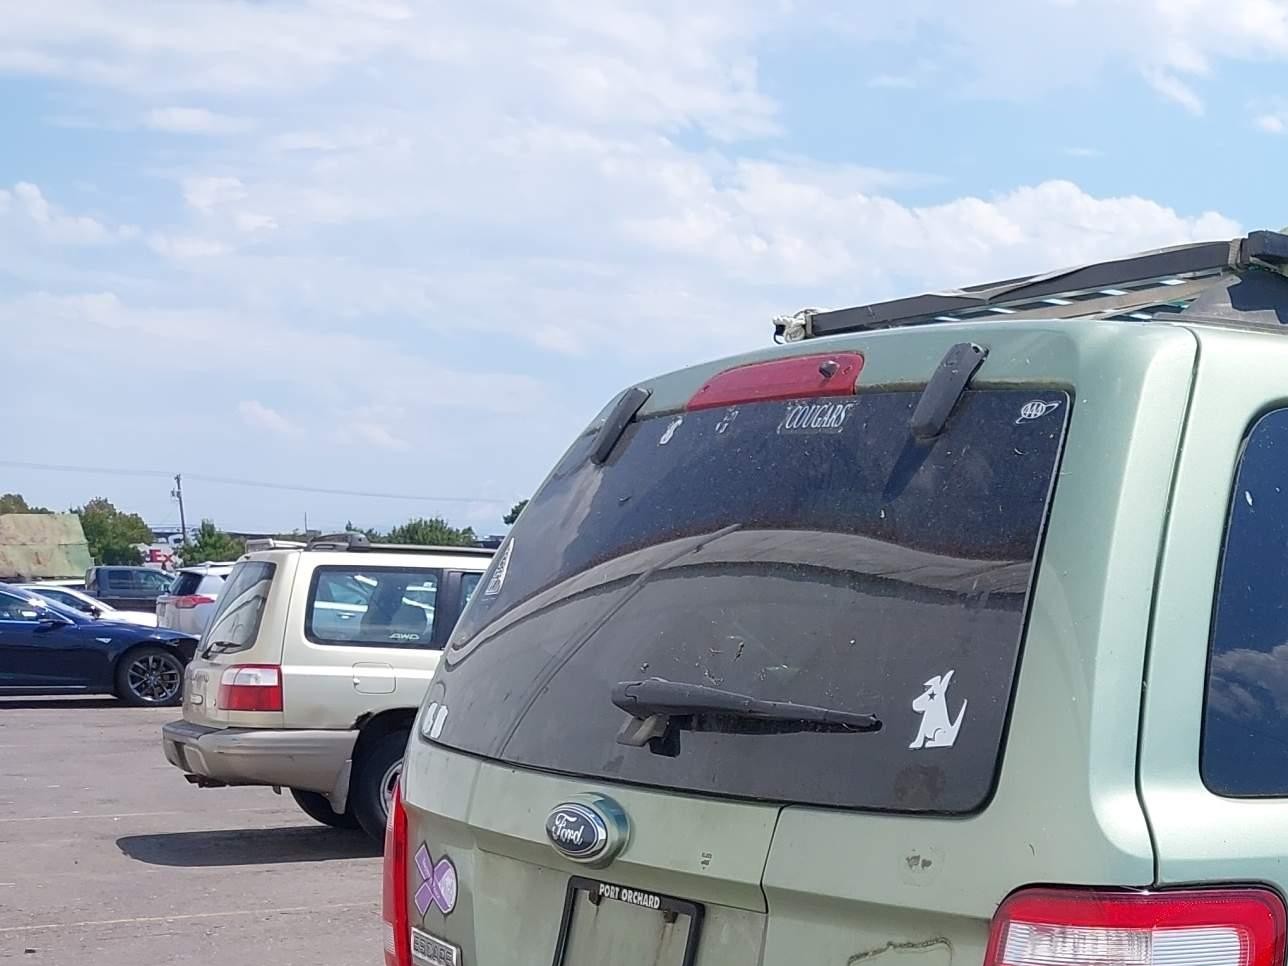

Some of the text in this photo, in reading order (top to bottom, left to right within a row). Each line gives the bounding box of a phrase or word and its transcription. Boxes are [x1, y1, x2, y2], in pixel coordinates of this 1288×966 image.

[786, 403, 851, 429] COUGARS
[552, 813, 584, 846] Ford
[599, 883, 660, 909] PORT ORCHARD
